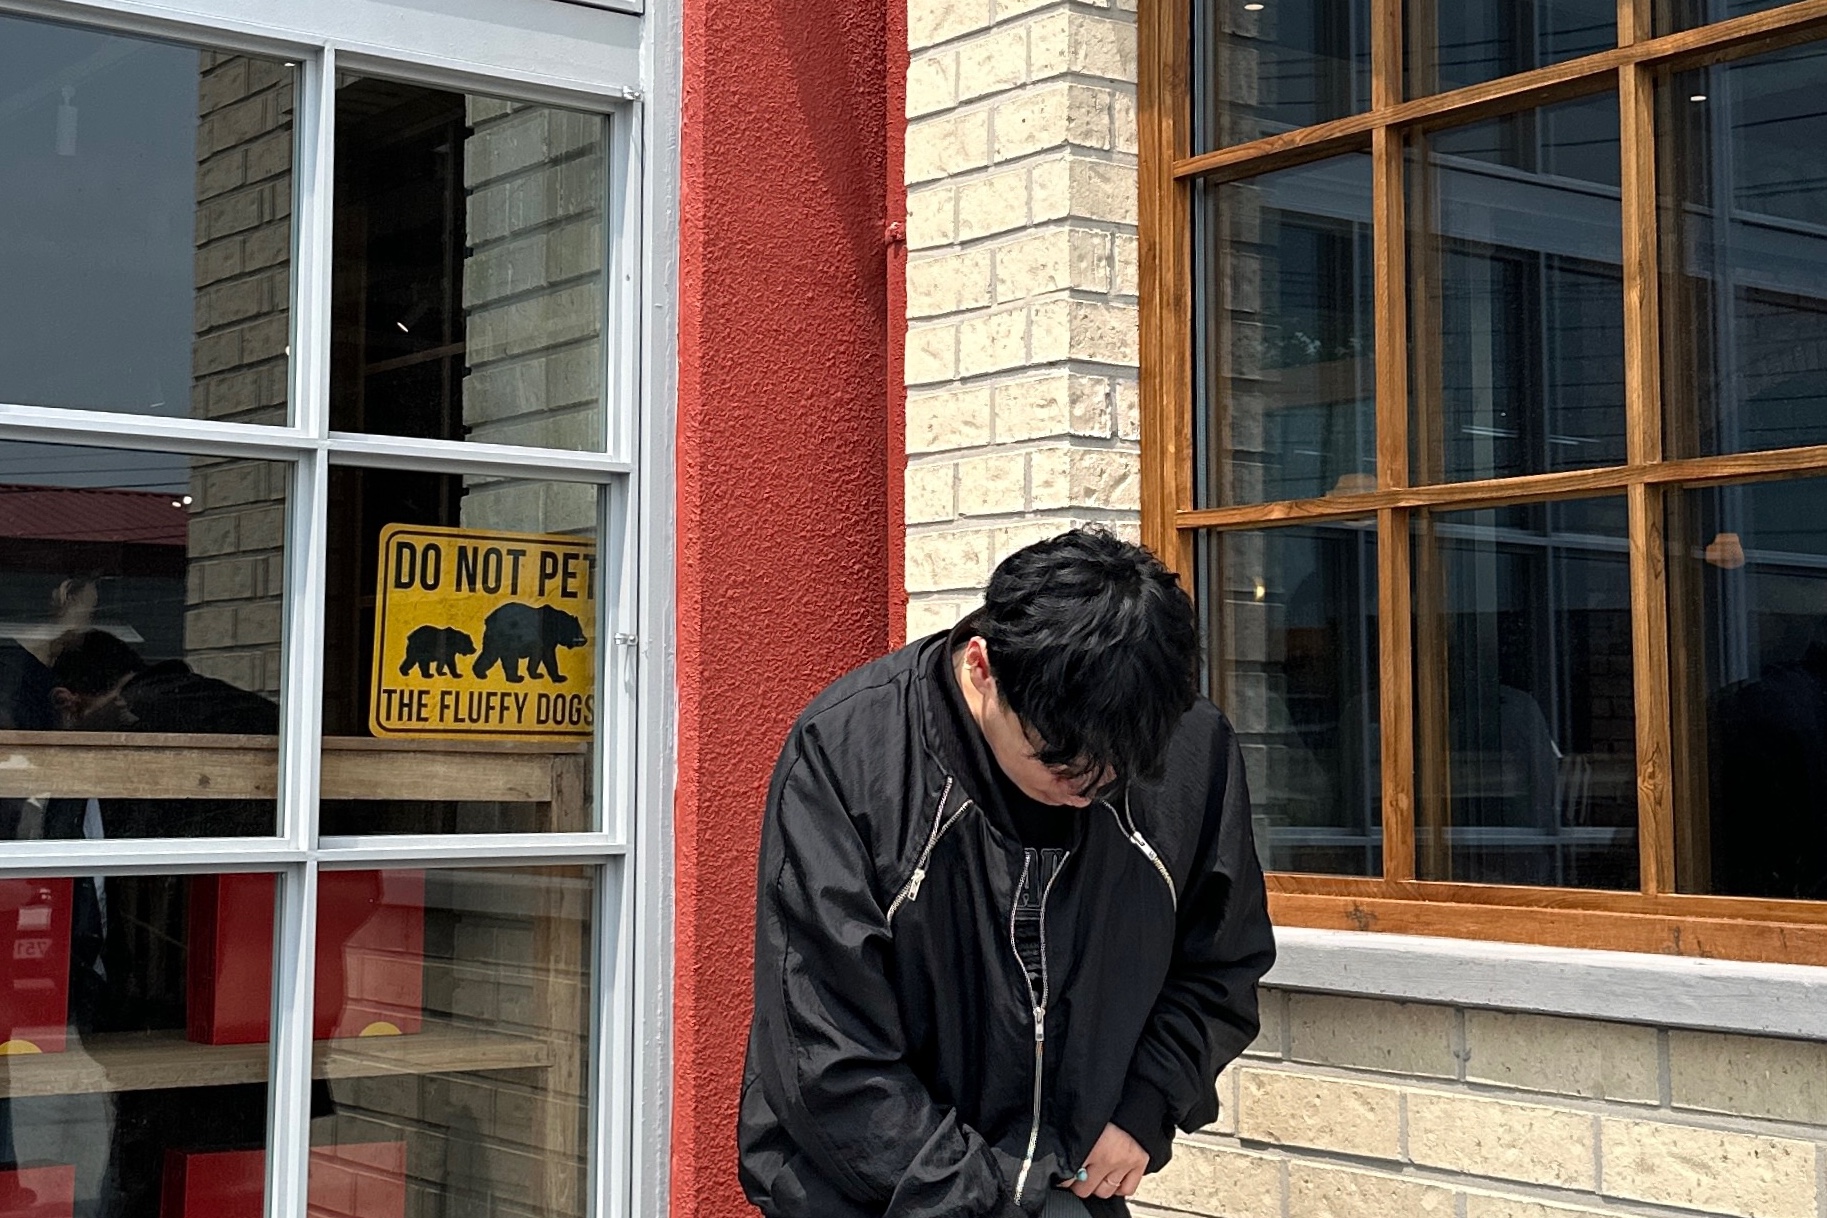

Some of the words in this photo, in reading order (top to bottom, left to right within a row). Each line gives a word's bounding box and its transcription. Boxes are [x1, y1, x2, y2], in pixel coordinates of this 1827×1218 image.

[394, 541, 442, 591] DO
[455, 545, 526, 595] NOT
[538, 550, 596, 600] PET
[382, 688, 431, 722] THE
[438, 690, 529, 725] FLUFFY
[536, 692, 595, 726] DOGS
